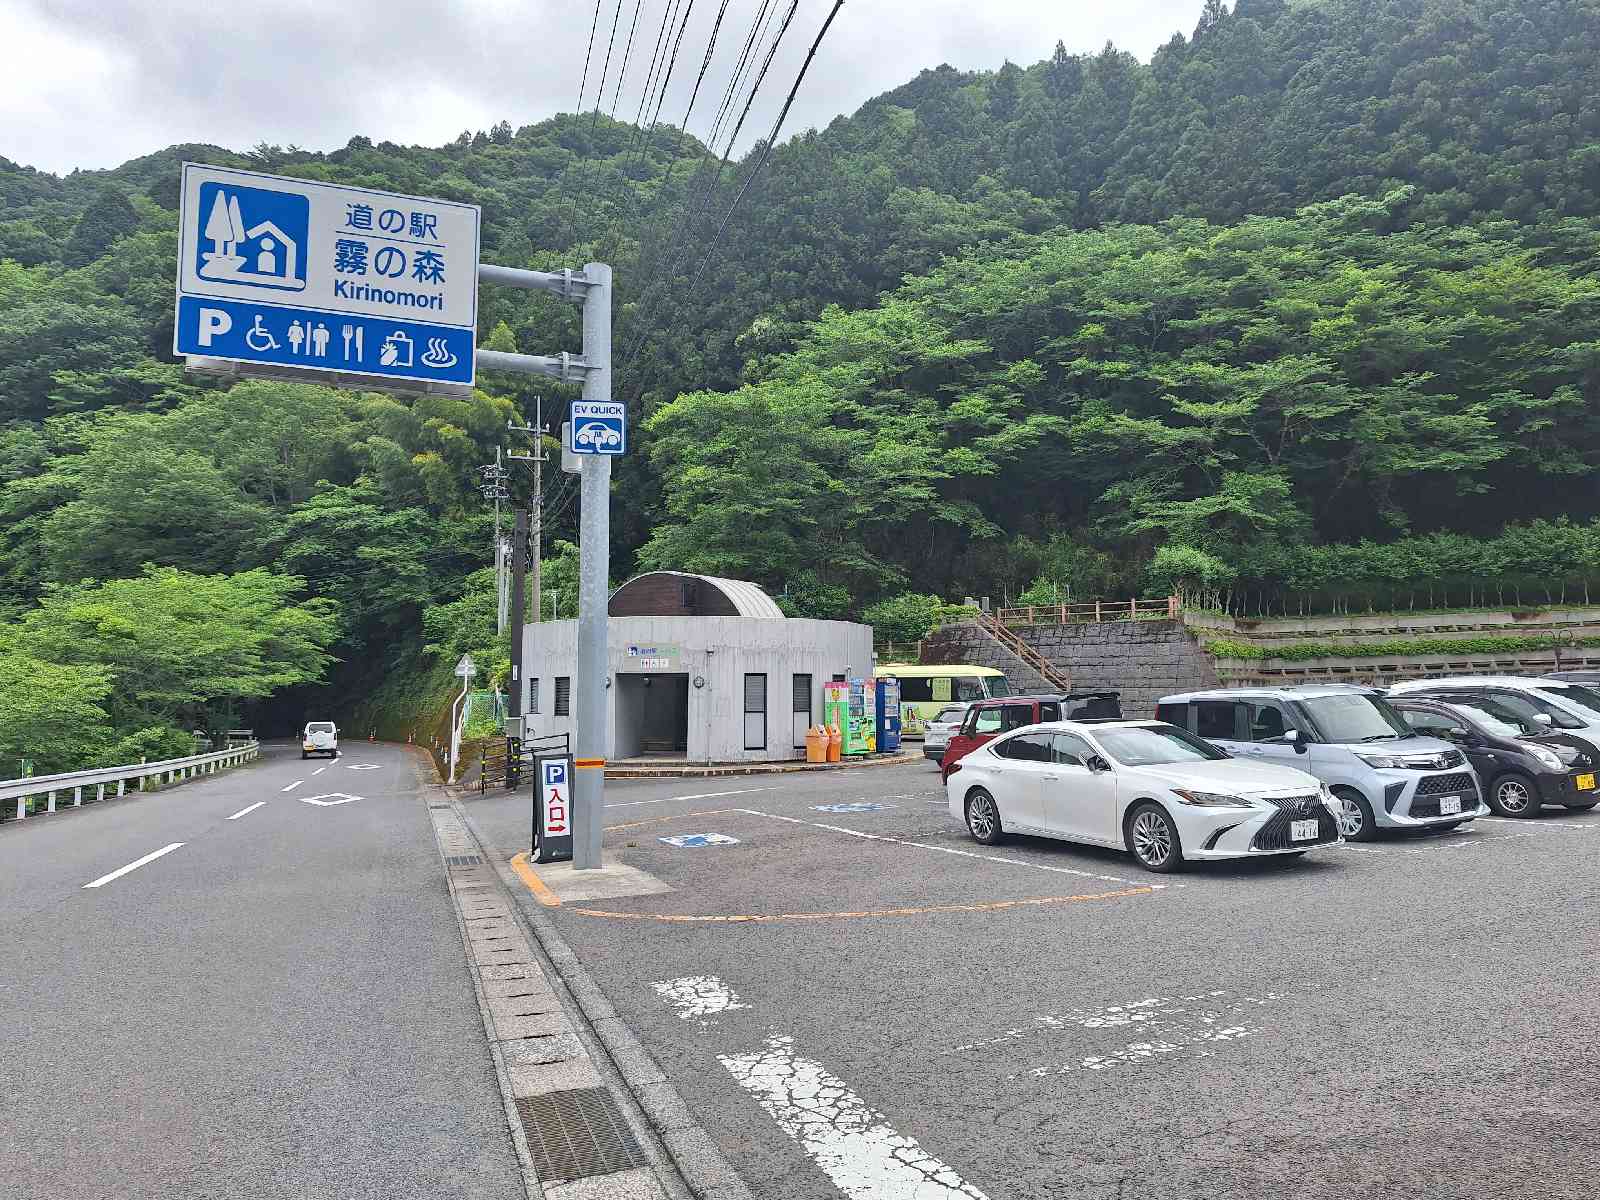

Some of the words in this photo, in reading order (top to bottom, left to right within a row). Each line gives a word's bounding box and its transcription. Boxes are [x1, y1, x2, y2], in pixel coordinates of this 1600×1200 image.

[345, 203, 438, 240] 道の駅
[334, 239, 446, 285] 霧の森
[334, 280, 443, 310] Kirinomori
[198, 307, 233, 347] P
[575, 405, 587, 414] EV
[591, 406, 622, 415] QUICK
[549, 766, 563, 783] P
[548, 788, 565, 822] 入口
